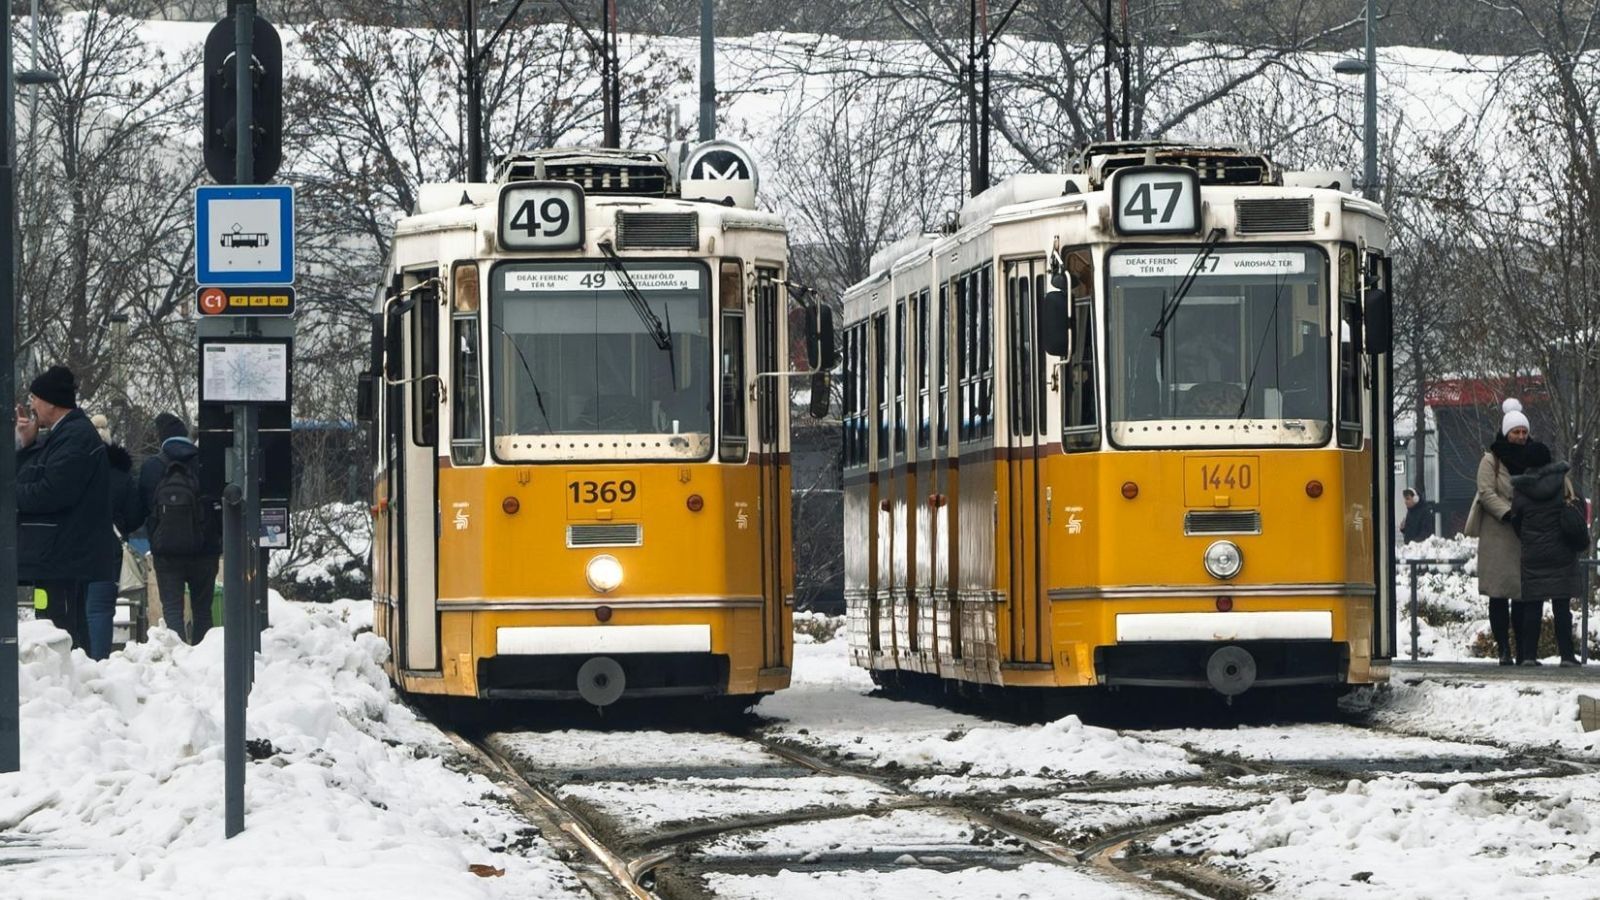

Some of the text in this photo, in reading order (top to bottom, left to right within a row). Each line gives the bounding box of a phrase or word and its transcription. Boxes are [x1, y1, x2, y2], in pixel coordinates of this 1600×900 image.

[1123, 181, 1184, 224] 47
[509, 197, 571, 238] 49
[1125, 257, 1147, 265] DEÁK
[1193, 256, 1220, 273] 47
[1233, 259, 1293, 268] VÁROSHÁZ TÉR
[1140, 265, 1155, 273] TÉR
[516, 273, 538, 281] DEÁK
[579, 272, 606, 289] 49
[630, 272, 675, 280] KELENFÖLD
[531, 280, 545, 288] TÉR
[204, 295, 222, 308] C1
[1201, 463, 1251, 491] 1440
[568, 479, 637, 504] 1369
